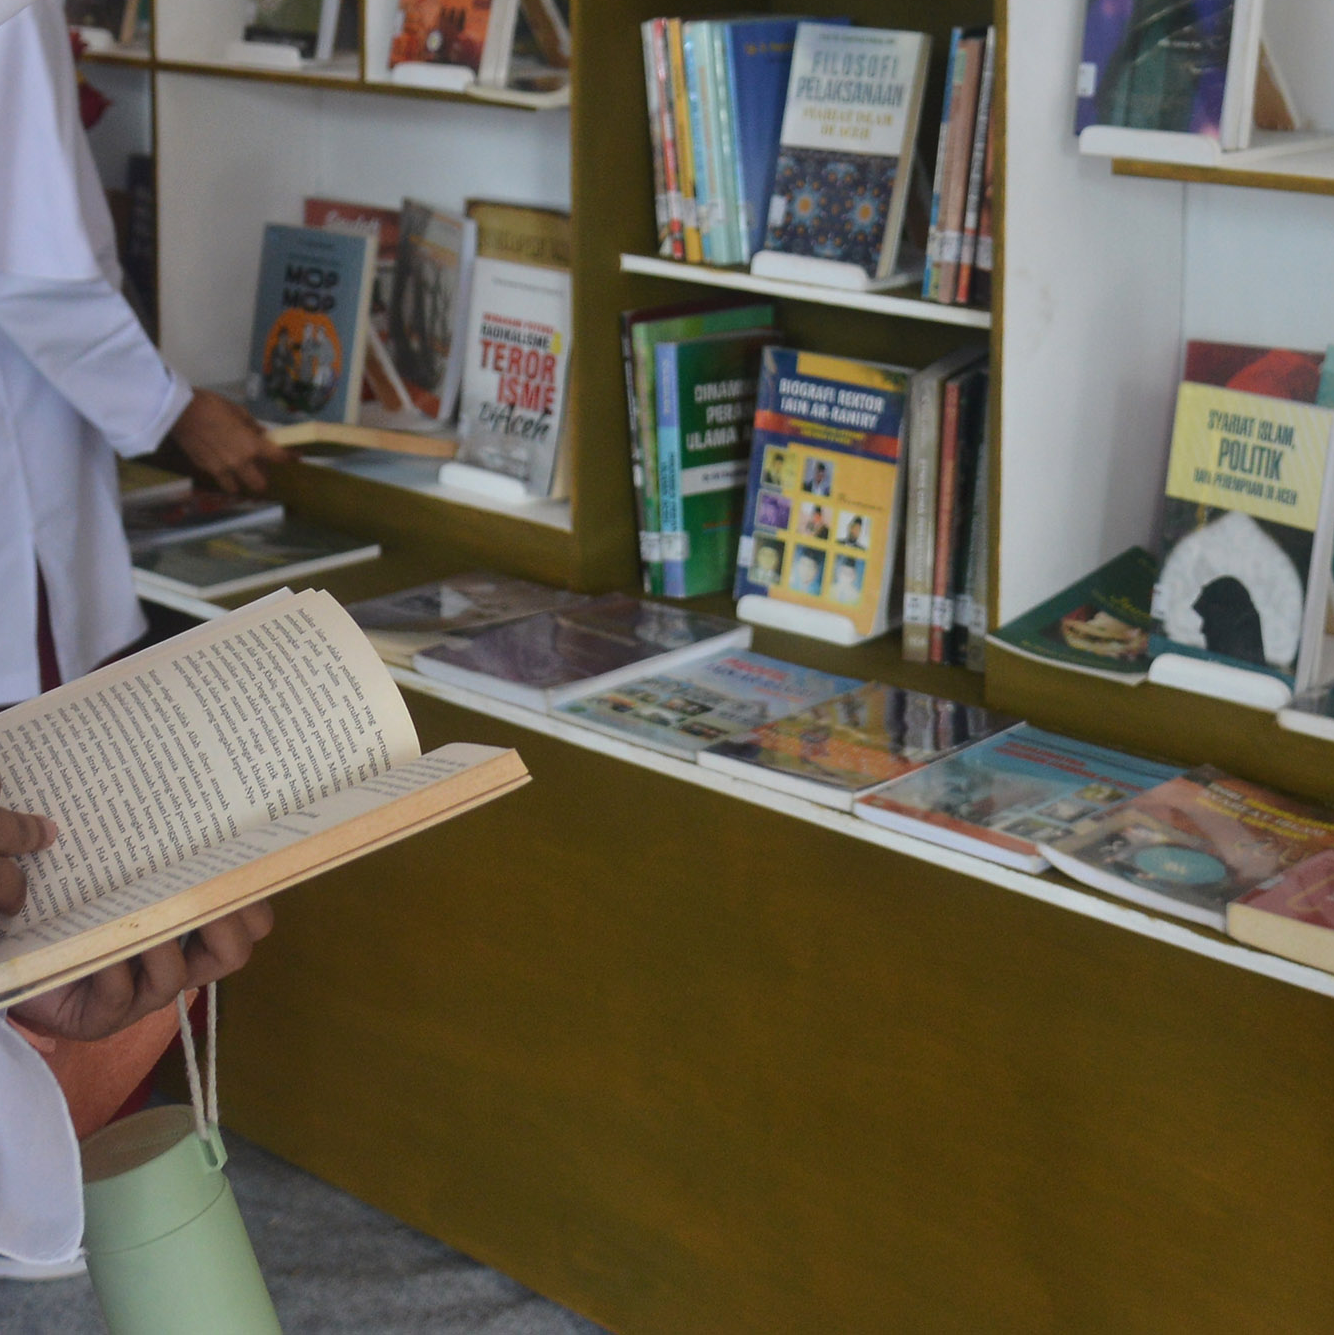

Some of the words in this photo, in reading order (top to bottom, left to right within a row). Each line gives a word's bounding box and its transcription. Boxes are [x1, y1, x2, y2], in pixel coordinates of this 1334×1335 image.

[811, 50, 900, 78] FILOSOFI
[796, 76, 905, 107] PELAKSANAAN
[479, 340, 556, 382] TEROR
[497, 377, 556, 413] ISME
[779, 377, 836, 404] BIOGRAFI
[837, 389, 886, 414] REKTOR
[686, 426, 738, 452] ULAMA
[1208, 409, 1254, 439] SYARIAT
[1257, 420, 1295, 450] ISLAM,
[1218, 437, 1284, 481] POLITIK
[300, 706, 316, 729] setiap
[310, 729, 332, 761] pribadi
[361, 704, 377, 727] yang
[236, 735, 256, 764] sebagai
[248, 727, 267, 756] sebagai
[265, 761, 279, 781] titik
[255, 715, 282, 757] pendidikan
[277, 757, 292, 780] yang
[285, 737, 301, 762] dapat
[323, 717, 347, 766] Pendidikan
[338, 717, 358, 754] manusia
[197, 751, 213, 775] diberi
[210, 777, 231, 811] amanah
[304, 745, 324, 783] manusia
[84, 786, 100, 814] bahwa
[97, 814, 117, 849] manusia
[151, 789, 167, 816] Hasan
[169, 793, 183, 811] oleh
[176, 776, 198, 809] Amanah
[193, 810, 204, 825] ini
[200, 790, 213, 812] alam
[58, 799, 74, 828] bahwa
[69, 827, 89, 862] manusia
[71, 793, 86, 811] akal
[79, 811, 91, 828] dan
[95, 845, 109, 864] Hal
[106, 796, 127, 834] kemauan
[123, 835, 138, 862] bebas
[122, 799, 146, 842] sedangkan
[142, 804, 160, 836] berupa
[174, 810, 196, 844] potensi
